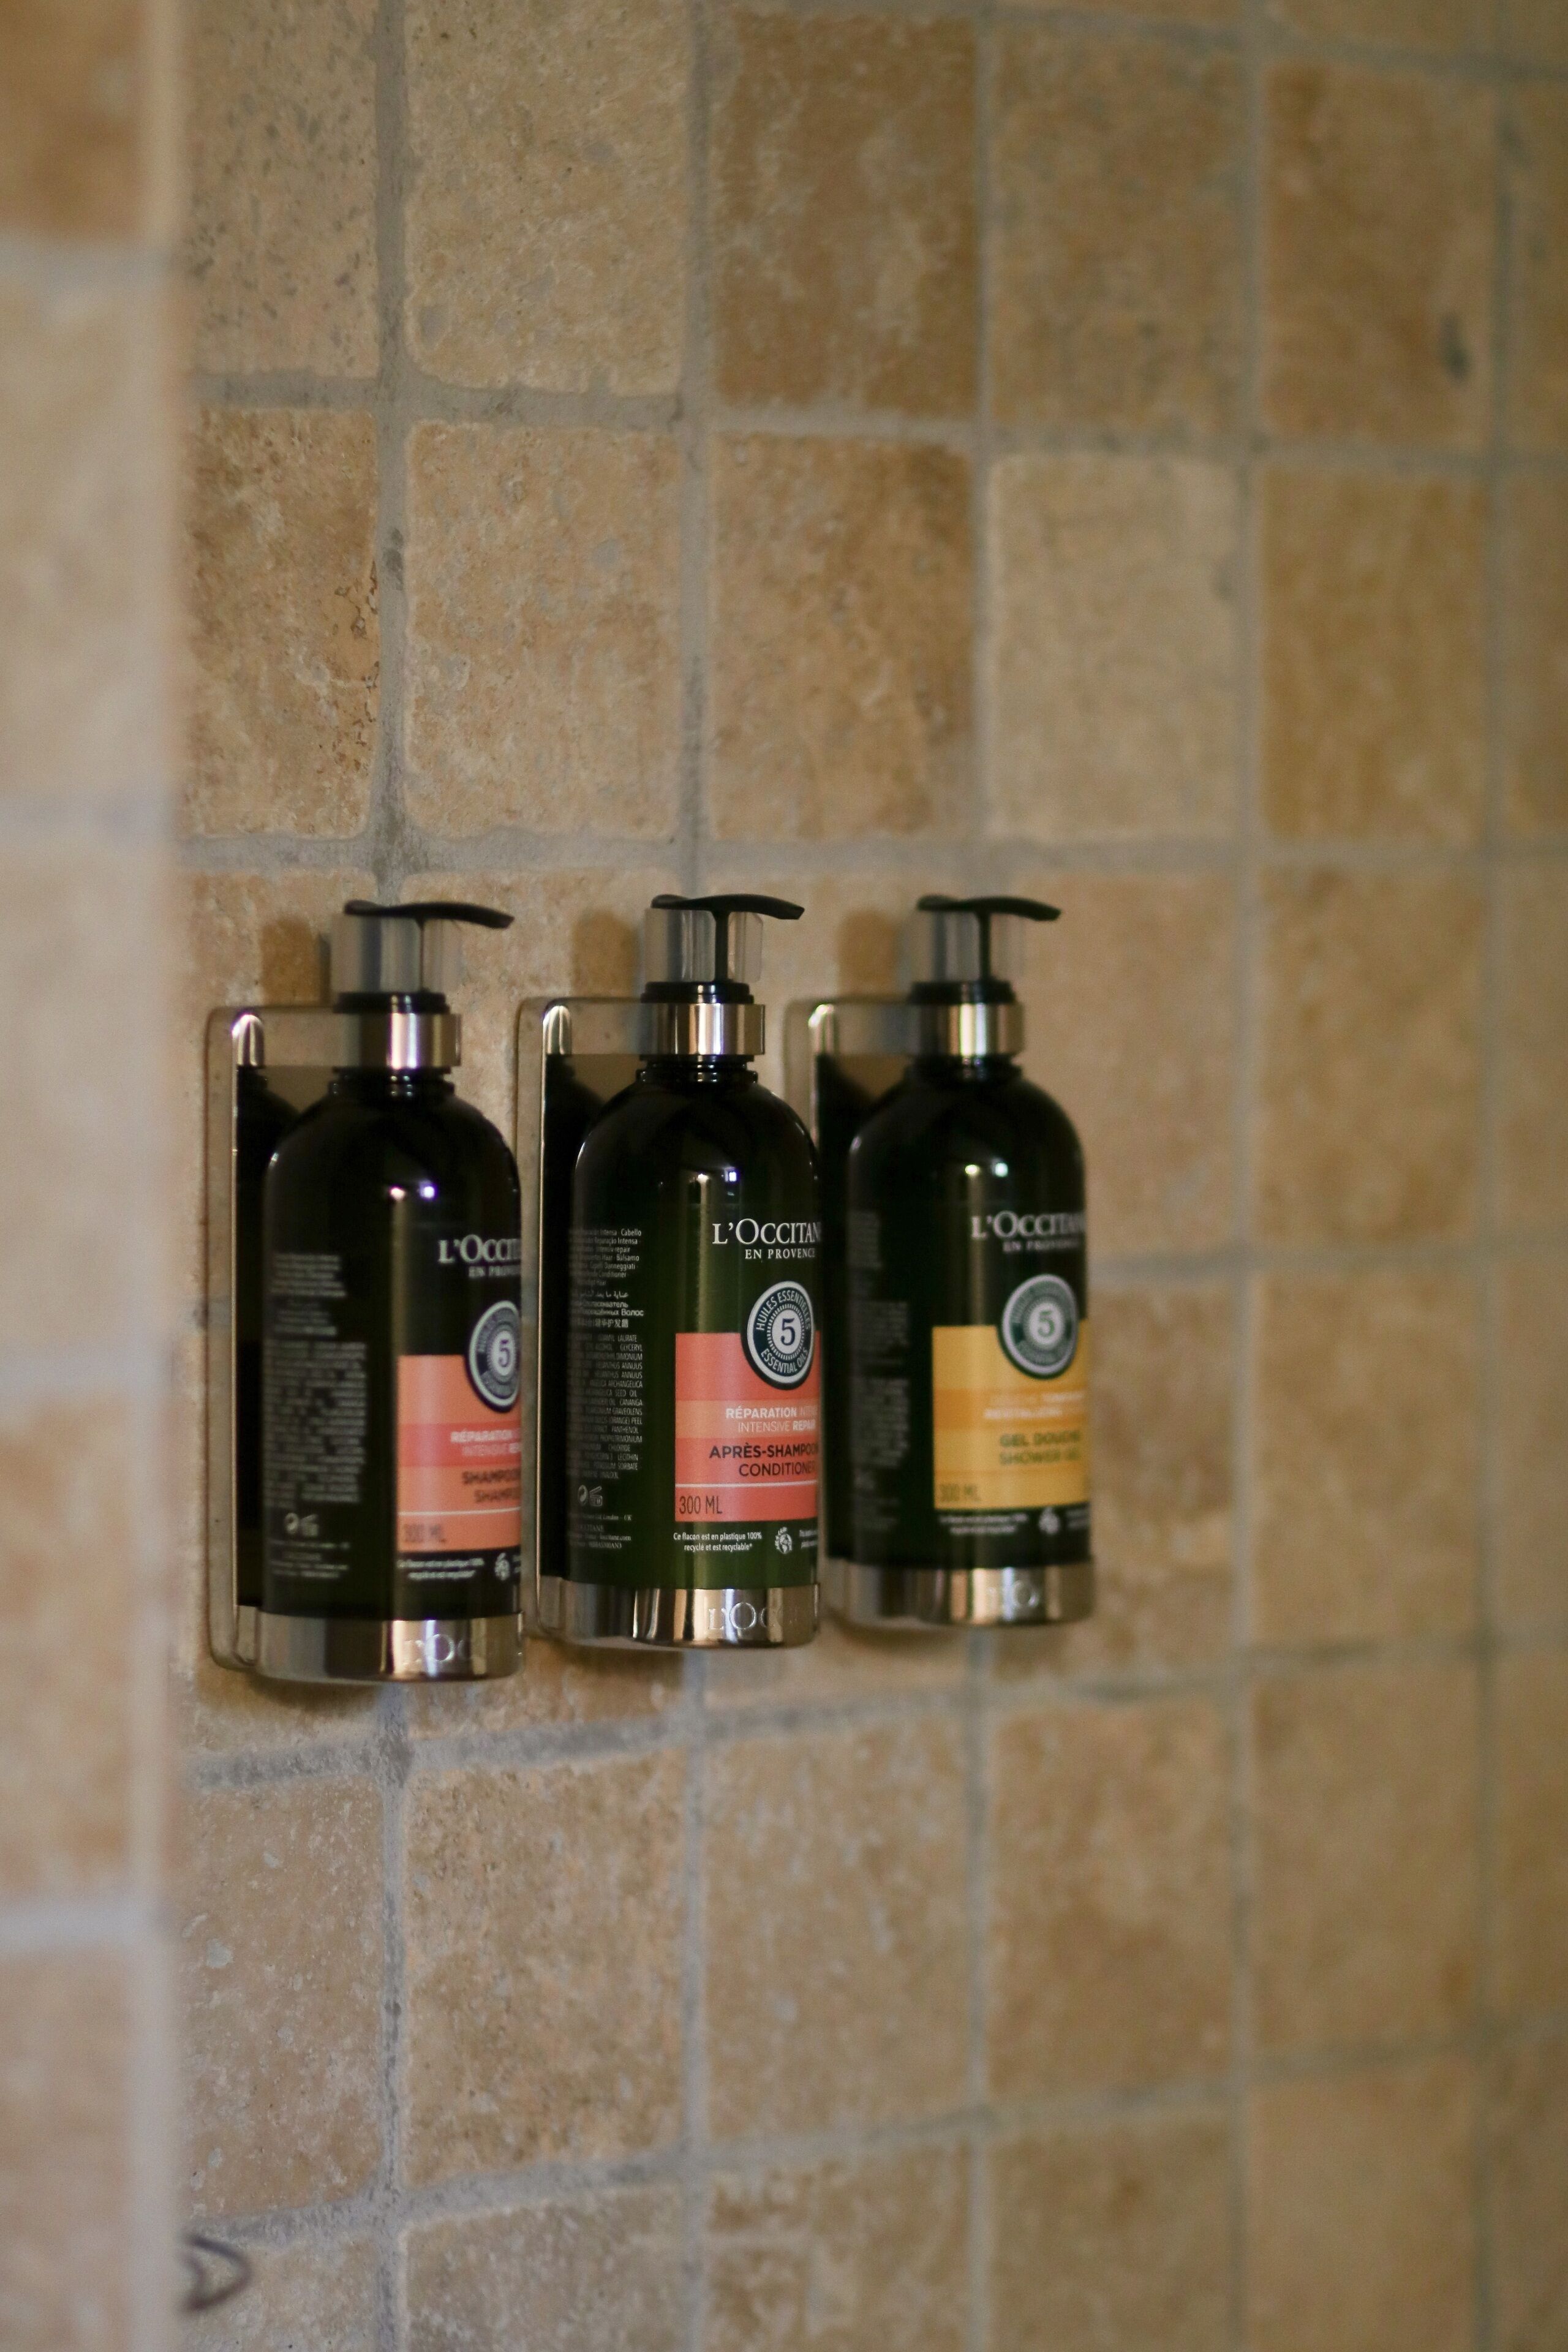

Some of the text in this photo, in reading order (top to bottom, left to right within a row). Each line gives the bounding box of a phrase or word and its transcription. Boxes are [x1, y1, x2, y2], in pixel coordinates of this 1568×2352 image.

[745, 1249, 762, 1259] EN
[756, 1296, 777, 1331] HUILES
[1038, 1310, 1055, 1338] 5
[780, 1318, 795, 1346] 5
[498, 1339, 510, 1368] 5
[761, 1347, 809, 1374] ESSENTIAL OILS
[621, 1371, 643, 1379] ANNUUS
[726, 1406, 796, 1419] RÉPARATION
[631, 1417, 643, 1425] PEEL
[738, 1421, 790, 1432] INTENSIVE
[617, 1462, 638, 1471] SORBATE
[679, 1496, 723, 1514] 300 ML
[682, 1532, 700, 1540] flacon
[720, 1532, 746, 1542] plastique
[684, 1543, 704, 1552] recyclé
